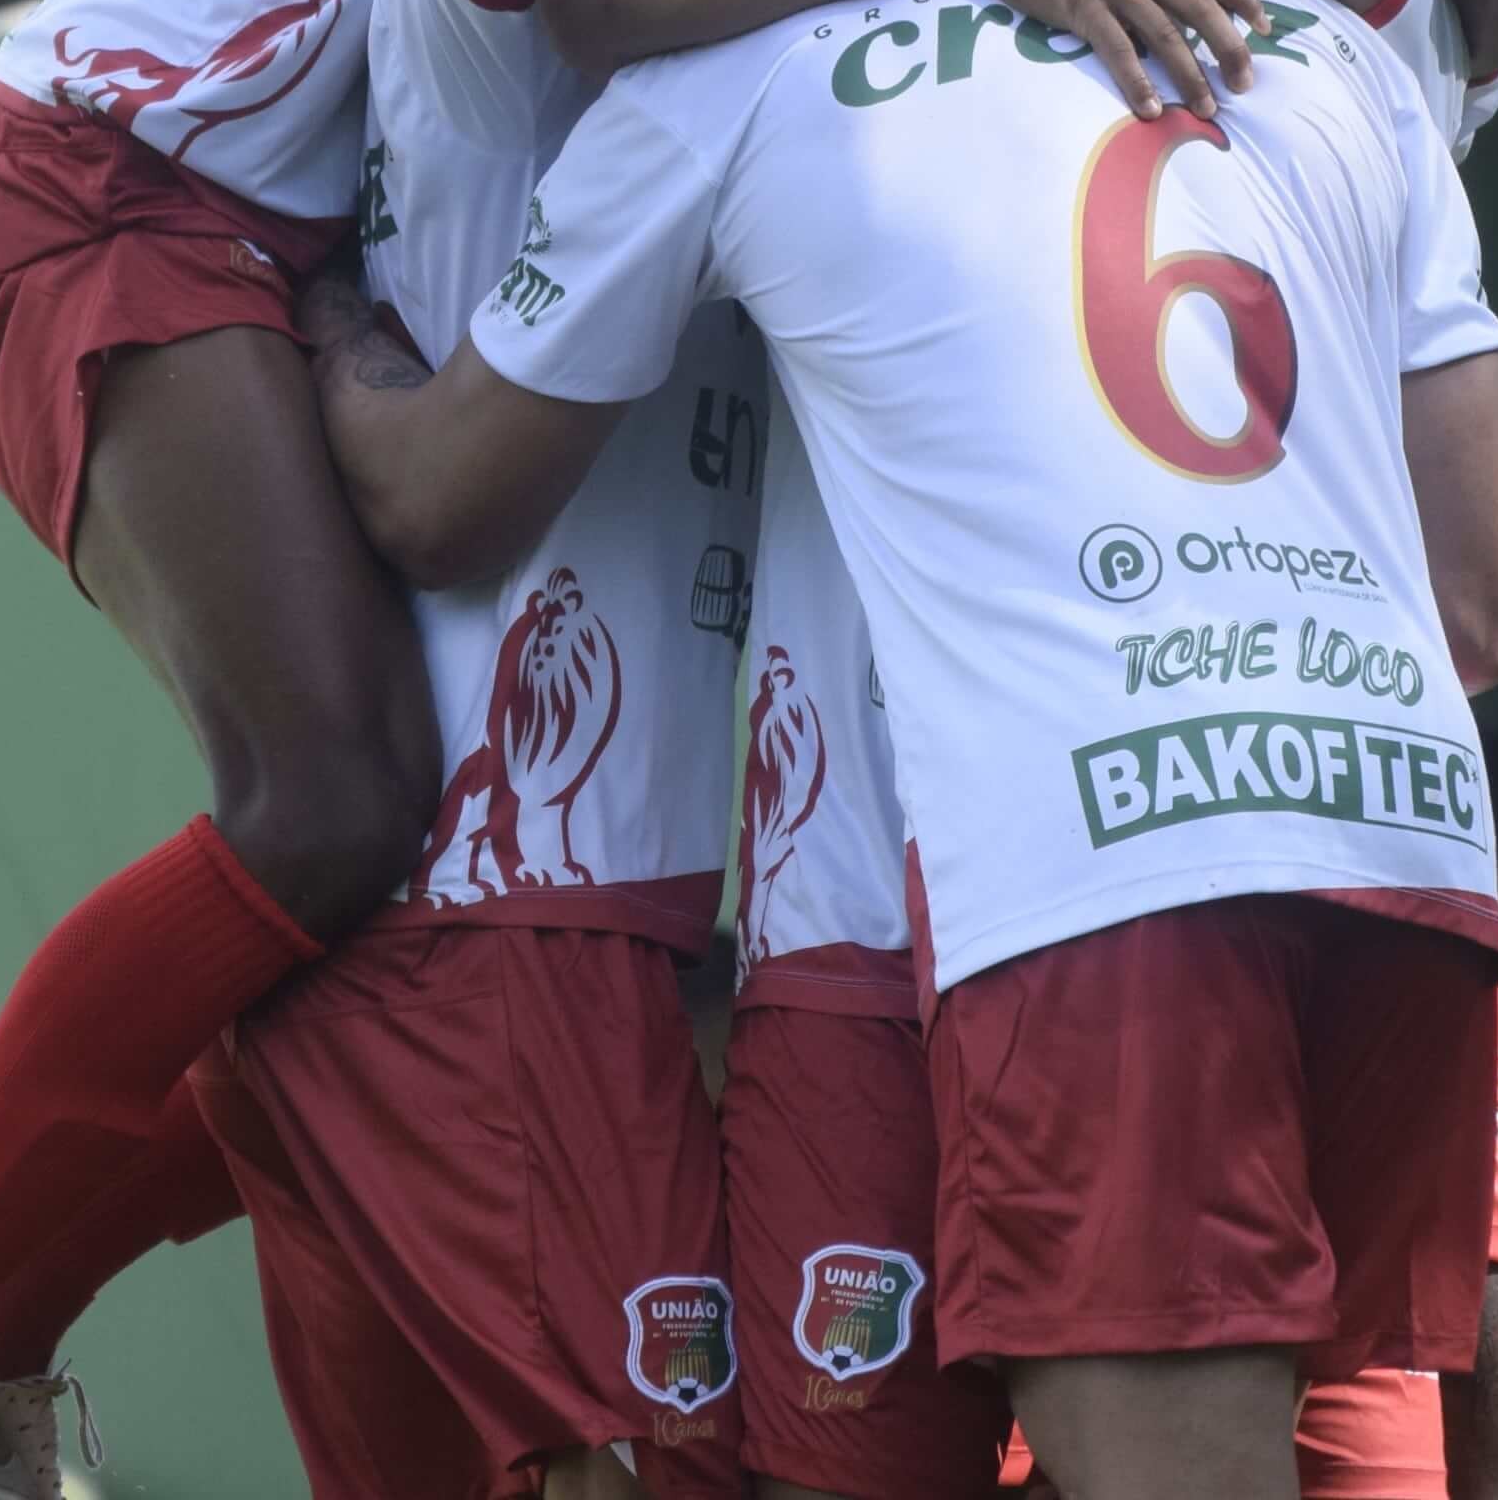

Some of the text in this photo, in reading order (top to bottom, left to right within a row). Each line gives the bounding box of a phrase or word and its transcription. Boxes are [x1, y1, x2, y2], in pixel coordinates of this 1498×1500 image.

[831, 0, 1321, 108] crez
[1070, 104, 1299, 486] 6
[1115, 616, 1424, 707] TCHE LOCO
[1087, 722, 1475, 833] BAKOFTEC
[651, 1298, 718, 1320] UNIÃO
[824, 1266, 897, 1294] UNIÃO
